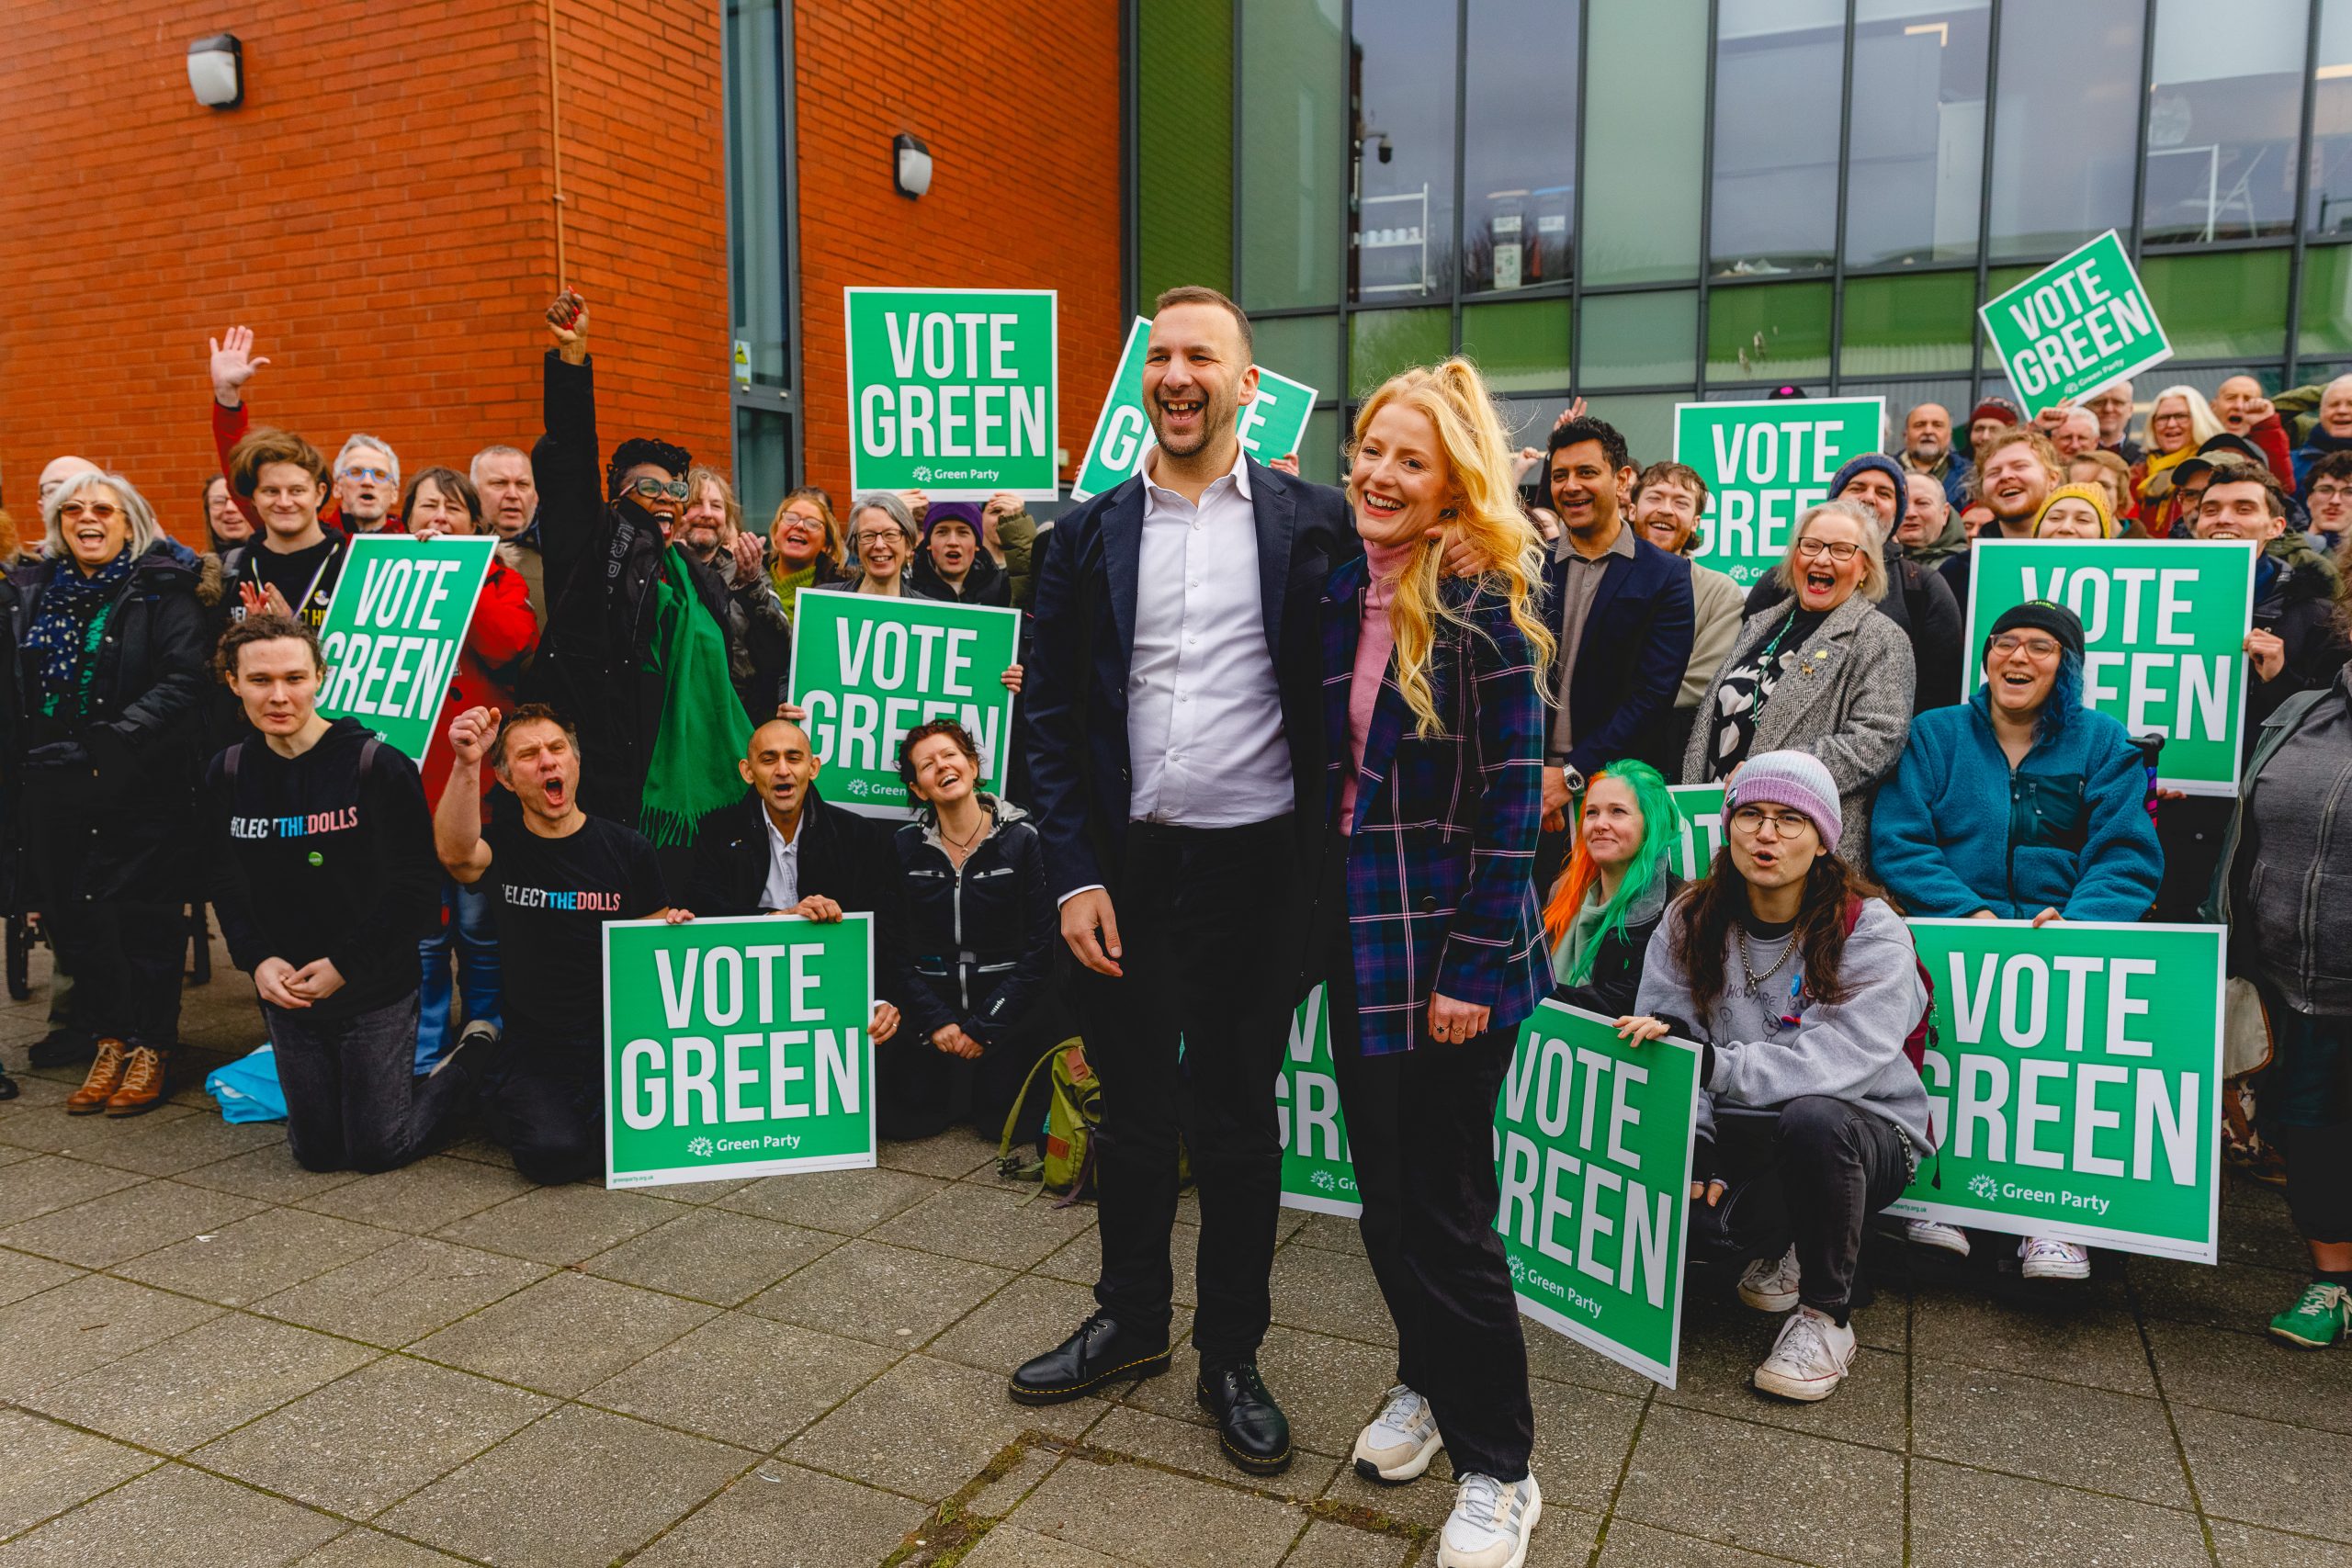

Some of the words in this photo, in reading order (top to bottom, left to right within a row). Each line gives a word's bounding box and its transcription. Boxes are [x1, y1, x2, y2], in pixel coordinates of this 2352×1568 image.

[2008, 258, 2111, 341] VOTE
[885, 312, 1018, 378] VOTE
[2013, 288, 2152, 396] GREEN
[861, 384, 1046, 457] GREEN
[1712, 420, 1844, 484] VOTE
[934, 468, 967, 479] Green
[970, 469, 1000, 482] Party
[1693, 489, 1828, 558] GRE
[354, 558, 461, 631] VOTE
[314, 631, 454, 721] GREEN
[836, 617, 978, 696] VOTE
[1980, 650, 2232, 742] EEN
[872, 784, 907, 796] Green
[502, 884, 621, 911] ELECTTHEDOLLS
[654, 943, 825, 1029] VOTE
[1751, 993, 1778, 1007] ARE
[1949, 952, 2156, 1057] VOTE
[621, 1027, 860, 1130] GREEN
[1506, 1031, 1648, 1170] VOTE
[717, 1138, 760, 1152] Green
[763, 1134, 800, 1149] Party
[1923, 1049, 2199, 1187] GREEN
[1493, 1125, 1672, 1309] REEN
[2002, 1182, 2055, 1204] Green
[2061, 1190, 2110, 1215] Party
[1528, 1269, 1565, 1298] Green
[1568, 1288, 1602, 1319] Party
